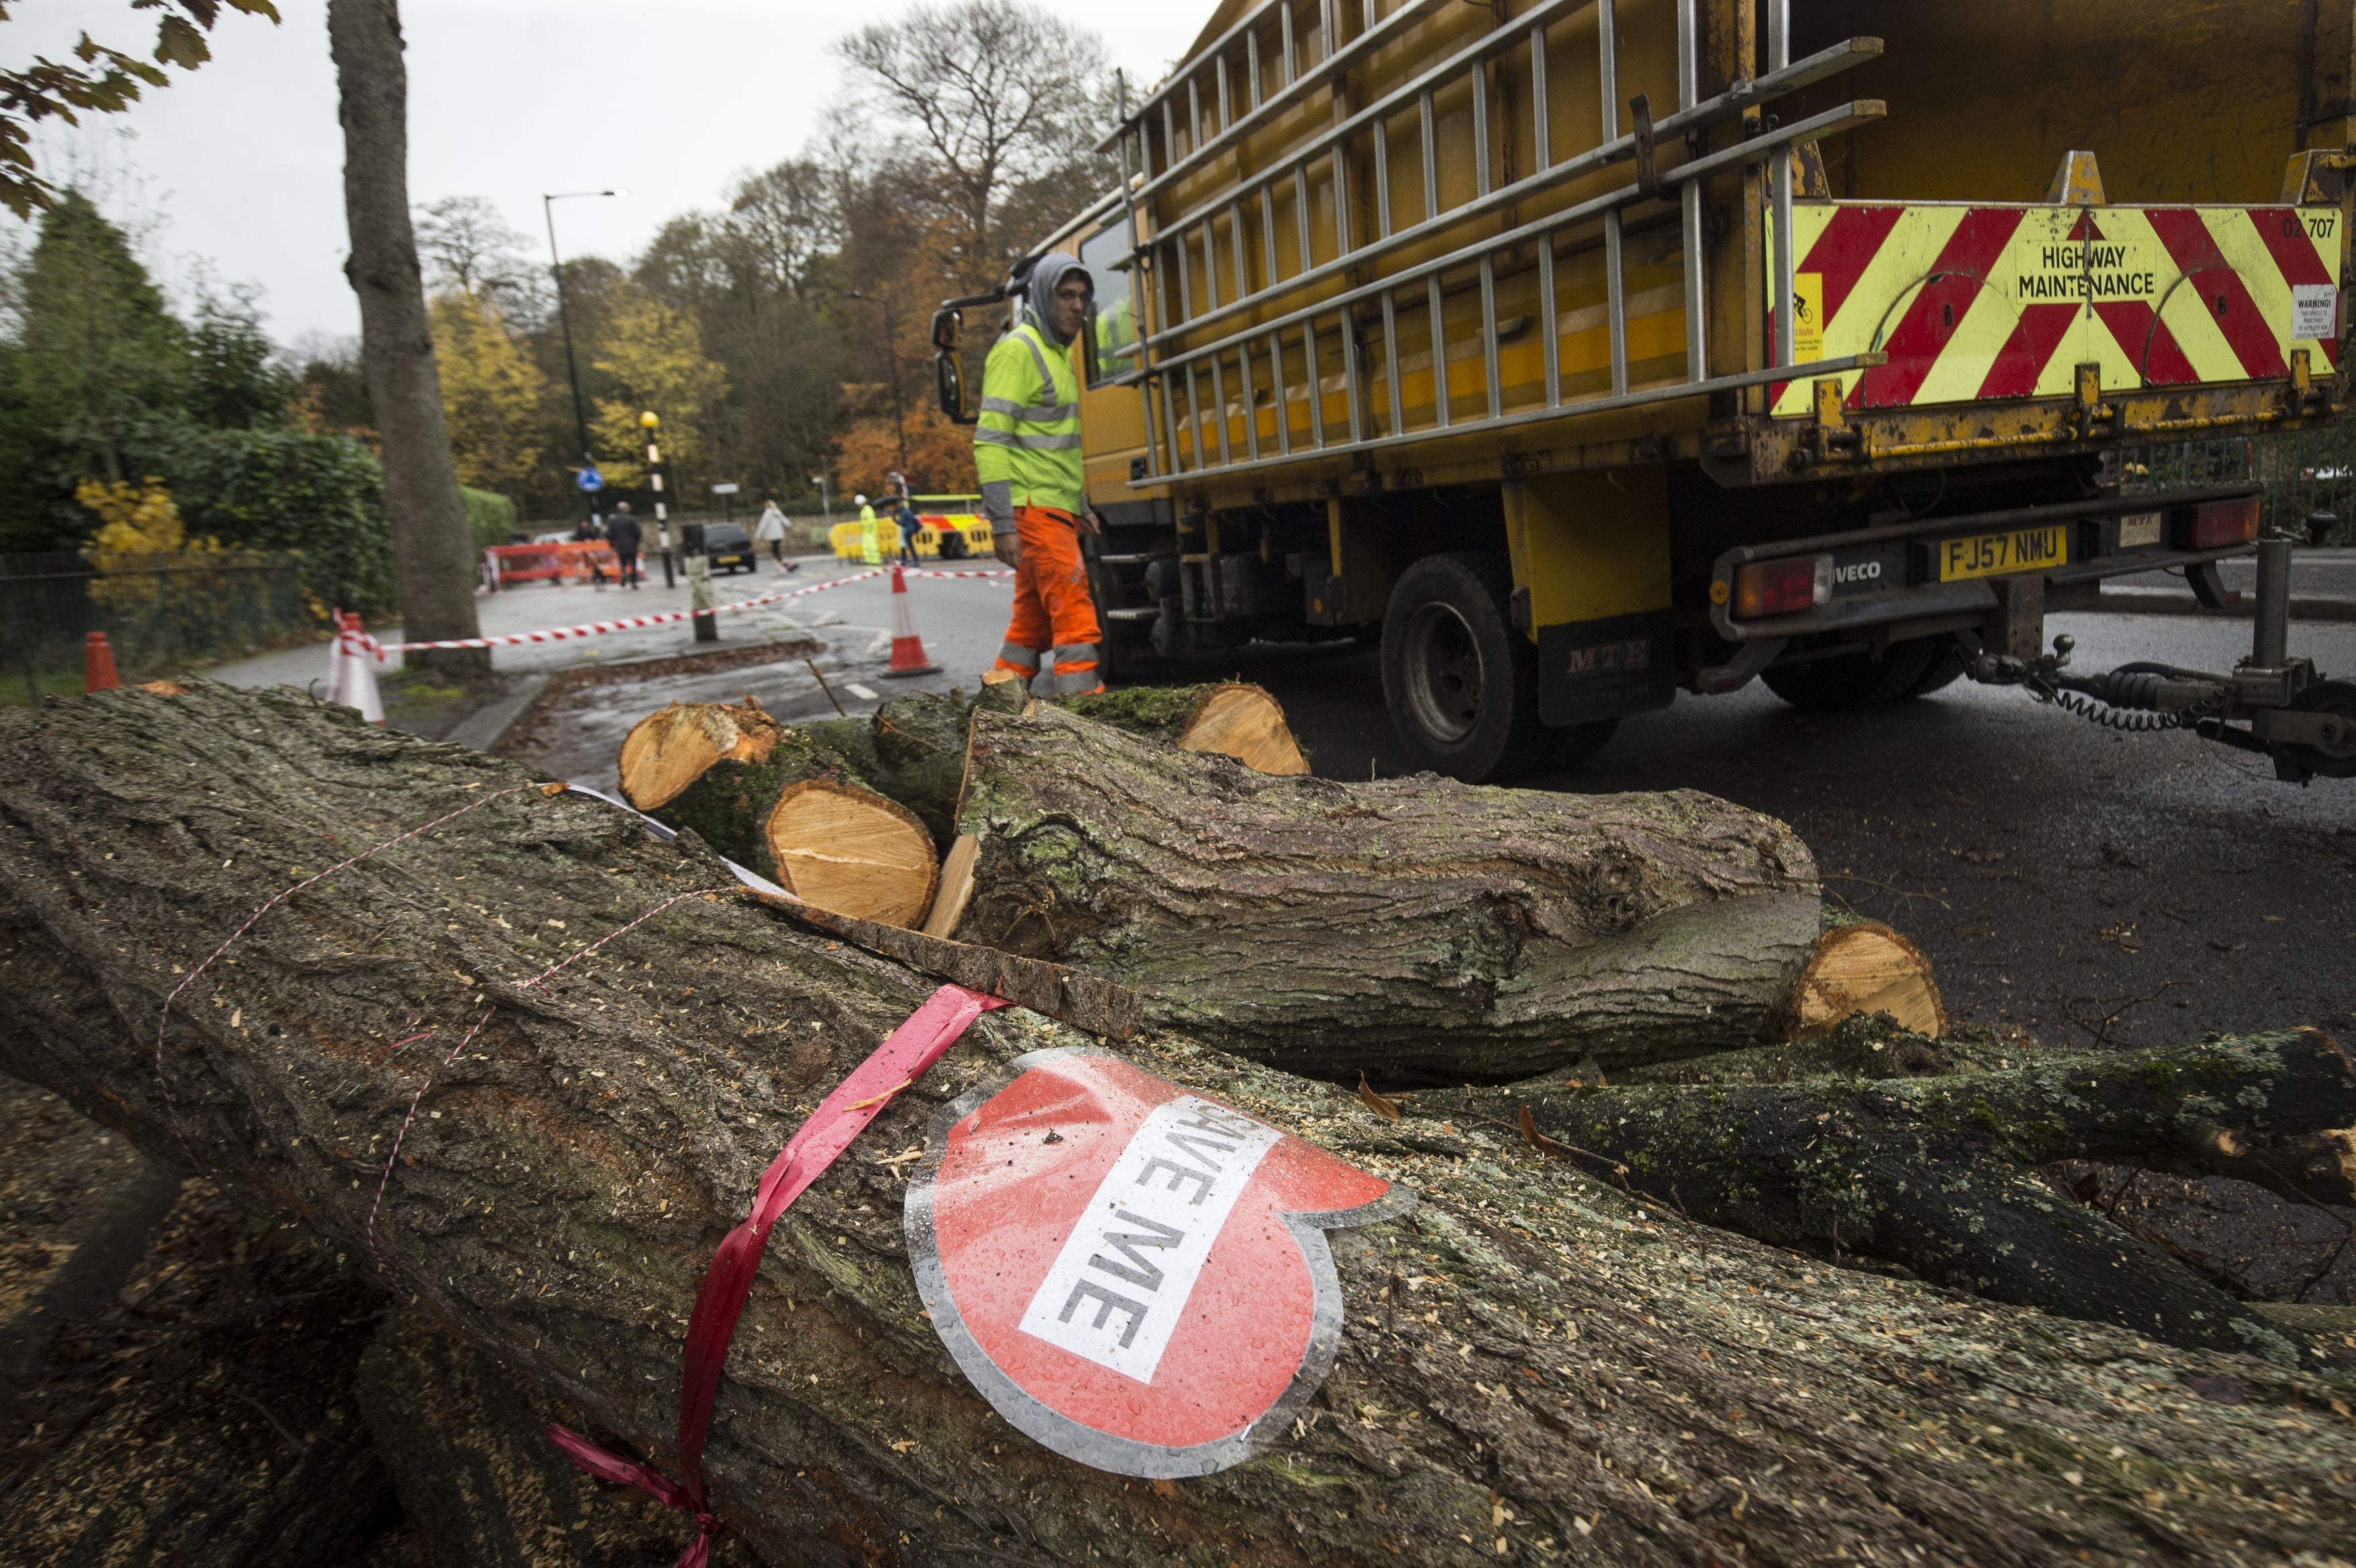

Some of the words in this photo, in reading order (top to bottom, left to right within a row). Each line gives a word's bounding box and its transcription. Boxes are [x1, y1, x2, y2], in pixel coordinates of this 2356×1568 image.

[2283, 218, 2301, 238] 02
[2309, 218, 2334, 238] 707
[2042, 246, 2126, 269] HIGHWAY
[2019, 273, 2154, 298] MAINTENANCE
[2298, 299, 2331, 308] WARNING!
[1795, 327, 1813, 336] clists
[1949, 536, 2009, 574] FJ57
[2016, 528, 2057, 564] NMU
[1567, 641, 1647, 674] MTE
[1135, 1104, 1259, 1207] SAVE
[1058, 1209, 1185, 1349] ME
